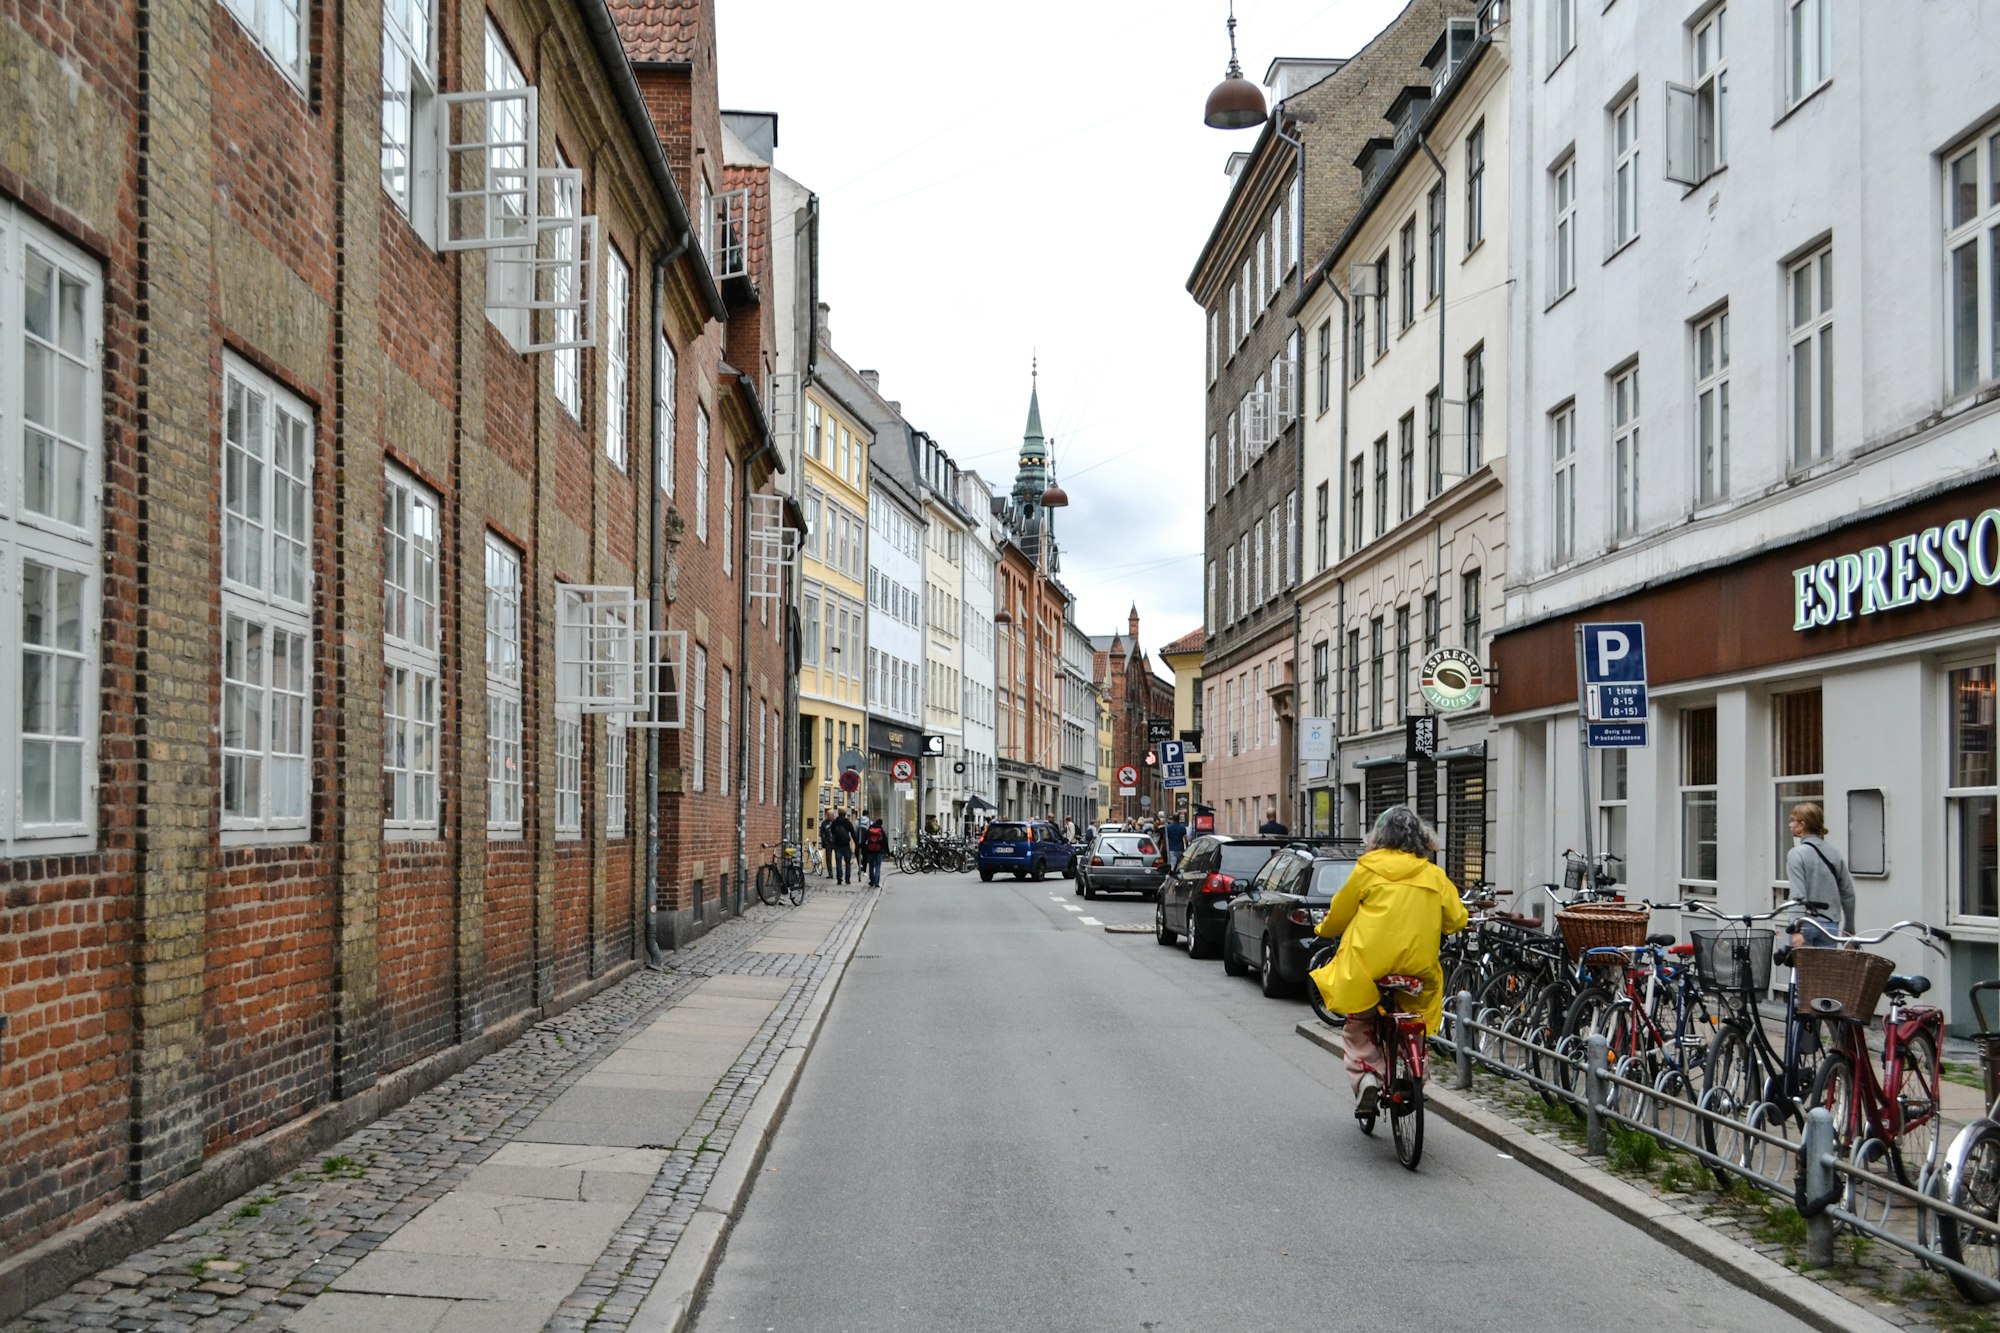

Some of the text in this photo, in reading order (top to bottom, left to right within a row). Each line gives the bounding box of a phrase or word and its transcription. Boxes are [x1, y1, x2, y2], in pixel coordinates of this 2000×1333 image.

[1792, 508, 2000, 631] ESPRESSO
[1424, 649, 1480, 675] ESPRESSO
[1597, 630, 1630, 677] P
[1607, 686, 1638, 695] 1 time
[1431, 692, 1474, 708] HOUSE
[1612, 697, 1634, 706] 8-15
[1609, 706, 1638, 716] (8-15)
[1166, 743, 1180, 762] P
